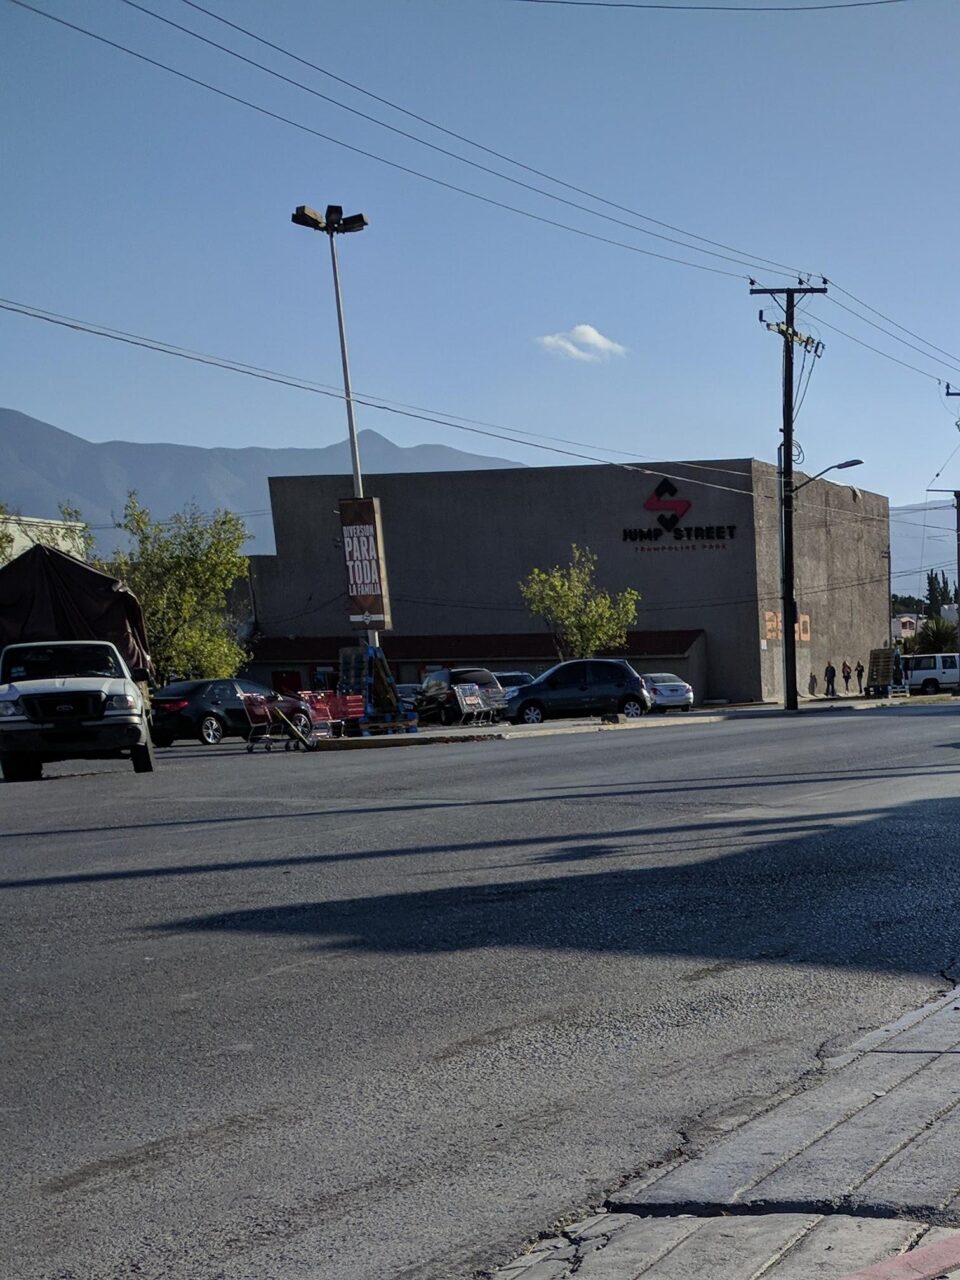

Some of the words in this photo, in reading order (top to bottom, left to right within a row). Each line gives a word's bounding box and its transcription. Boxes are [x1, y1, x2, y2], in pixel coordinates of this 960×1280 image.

[622, 528, 663, 541] JUMP
[673, 525, 737, 541] STREET
[344, 536, 377, 560] PARA
[702, 543, 727, 552] PARK
[346, 560, 379, 584] TODA
[349, 584, 358, 596] LA
[358, 583, 381, 596] FAMILIA
